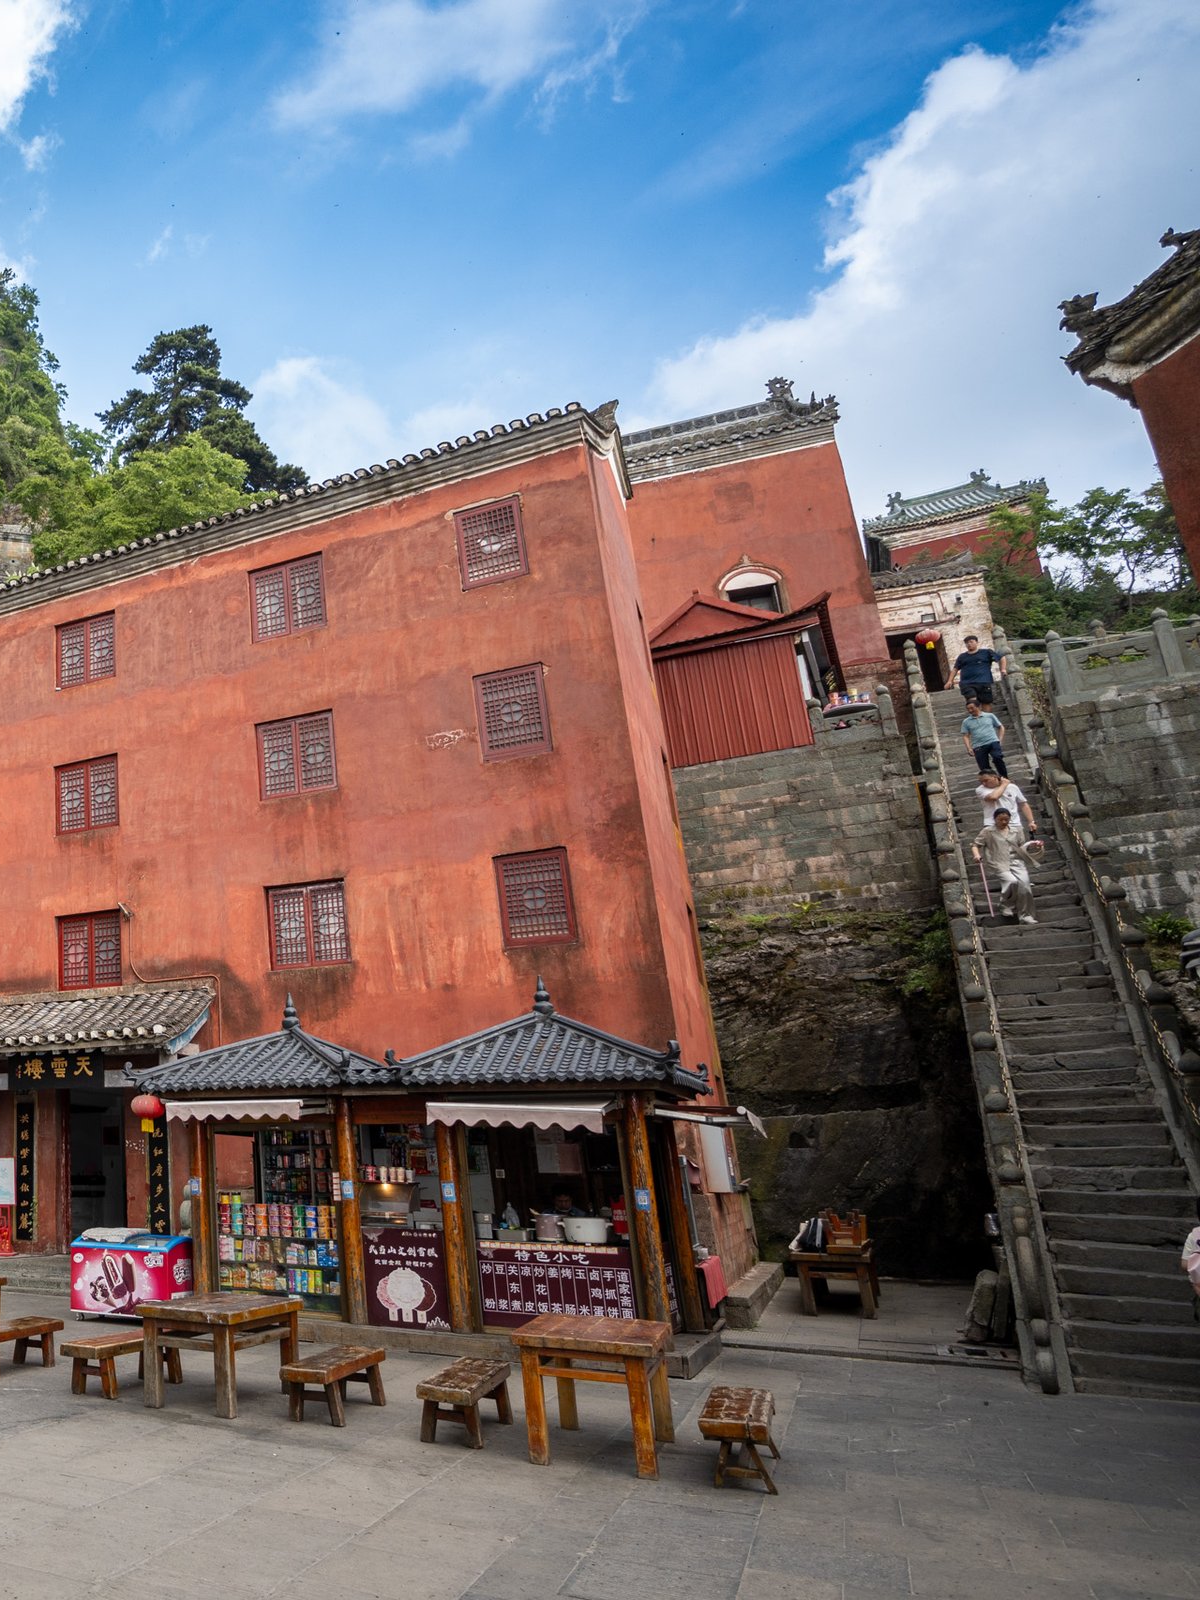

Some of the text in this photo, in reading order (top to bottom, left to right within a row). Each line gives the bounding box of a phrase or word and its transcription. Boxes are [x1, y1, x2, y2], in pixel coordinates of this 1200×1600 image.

[514, 1249, 590, 1265] 特色小吃
[481, 1263, 496, 1309] 炒粉
[495, 1264, 509, 1310] 豆浆
[507, 1265, 522, 1311] 关东煮
[520, 1266, 536, 1312] 凉皮
[533, 1267, 549, 1313] 炒花饭
[547, 1267, 563, 1314] 姜茶
[561, 1268, 577, 1315] 烤肠
[575, 1269, 590, 1316] 玉米
[589, 1270, 605, 1317] 卤鸡蛋
[603, 1270, 619, 1318] 手抓饼
[617, 1271, 634, 1319] 道家斋面
